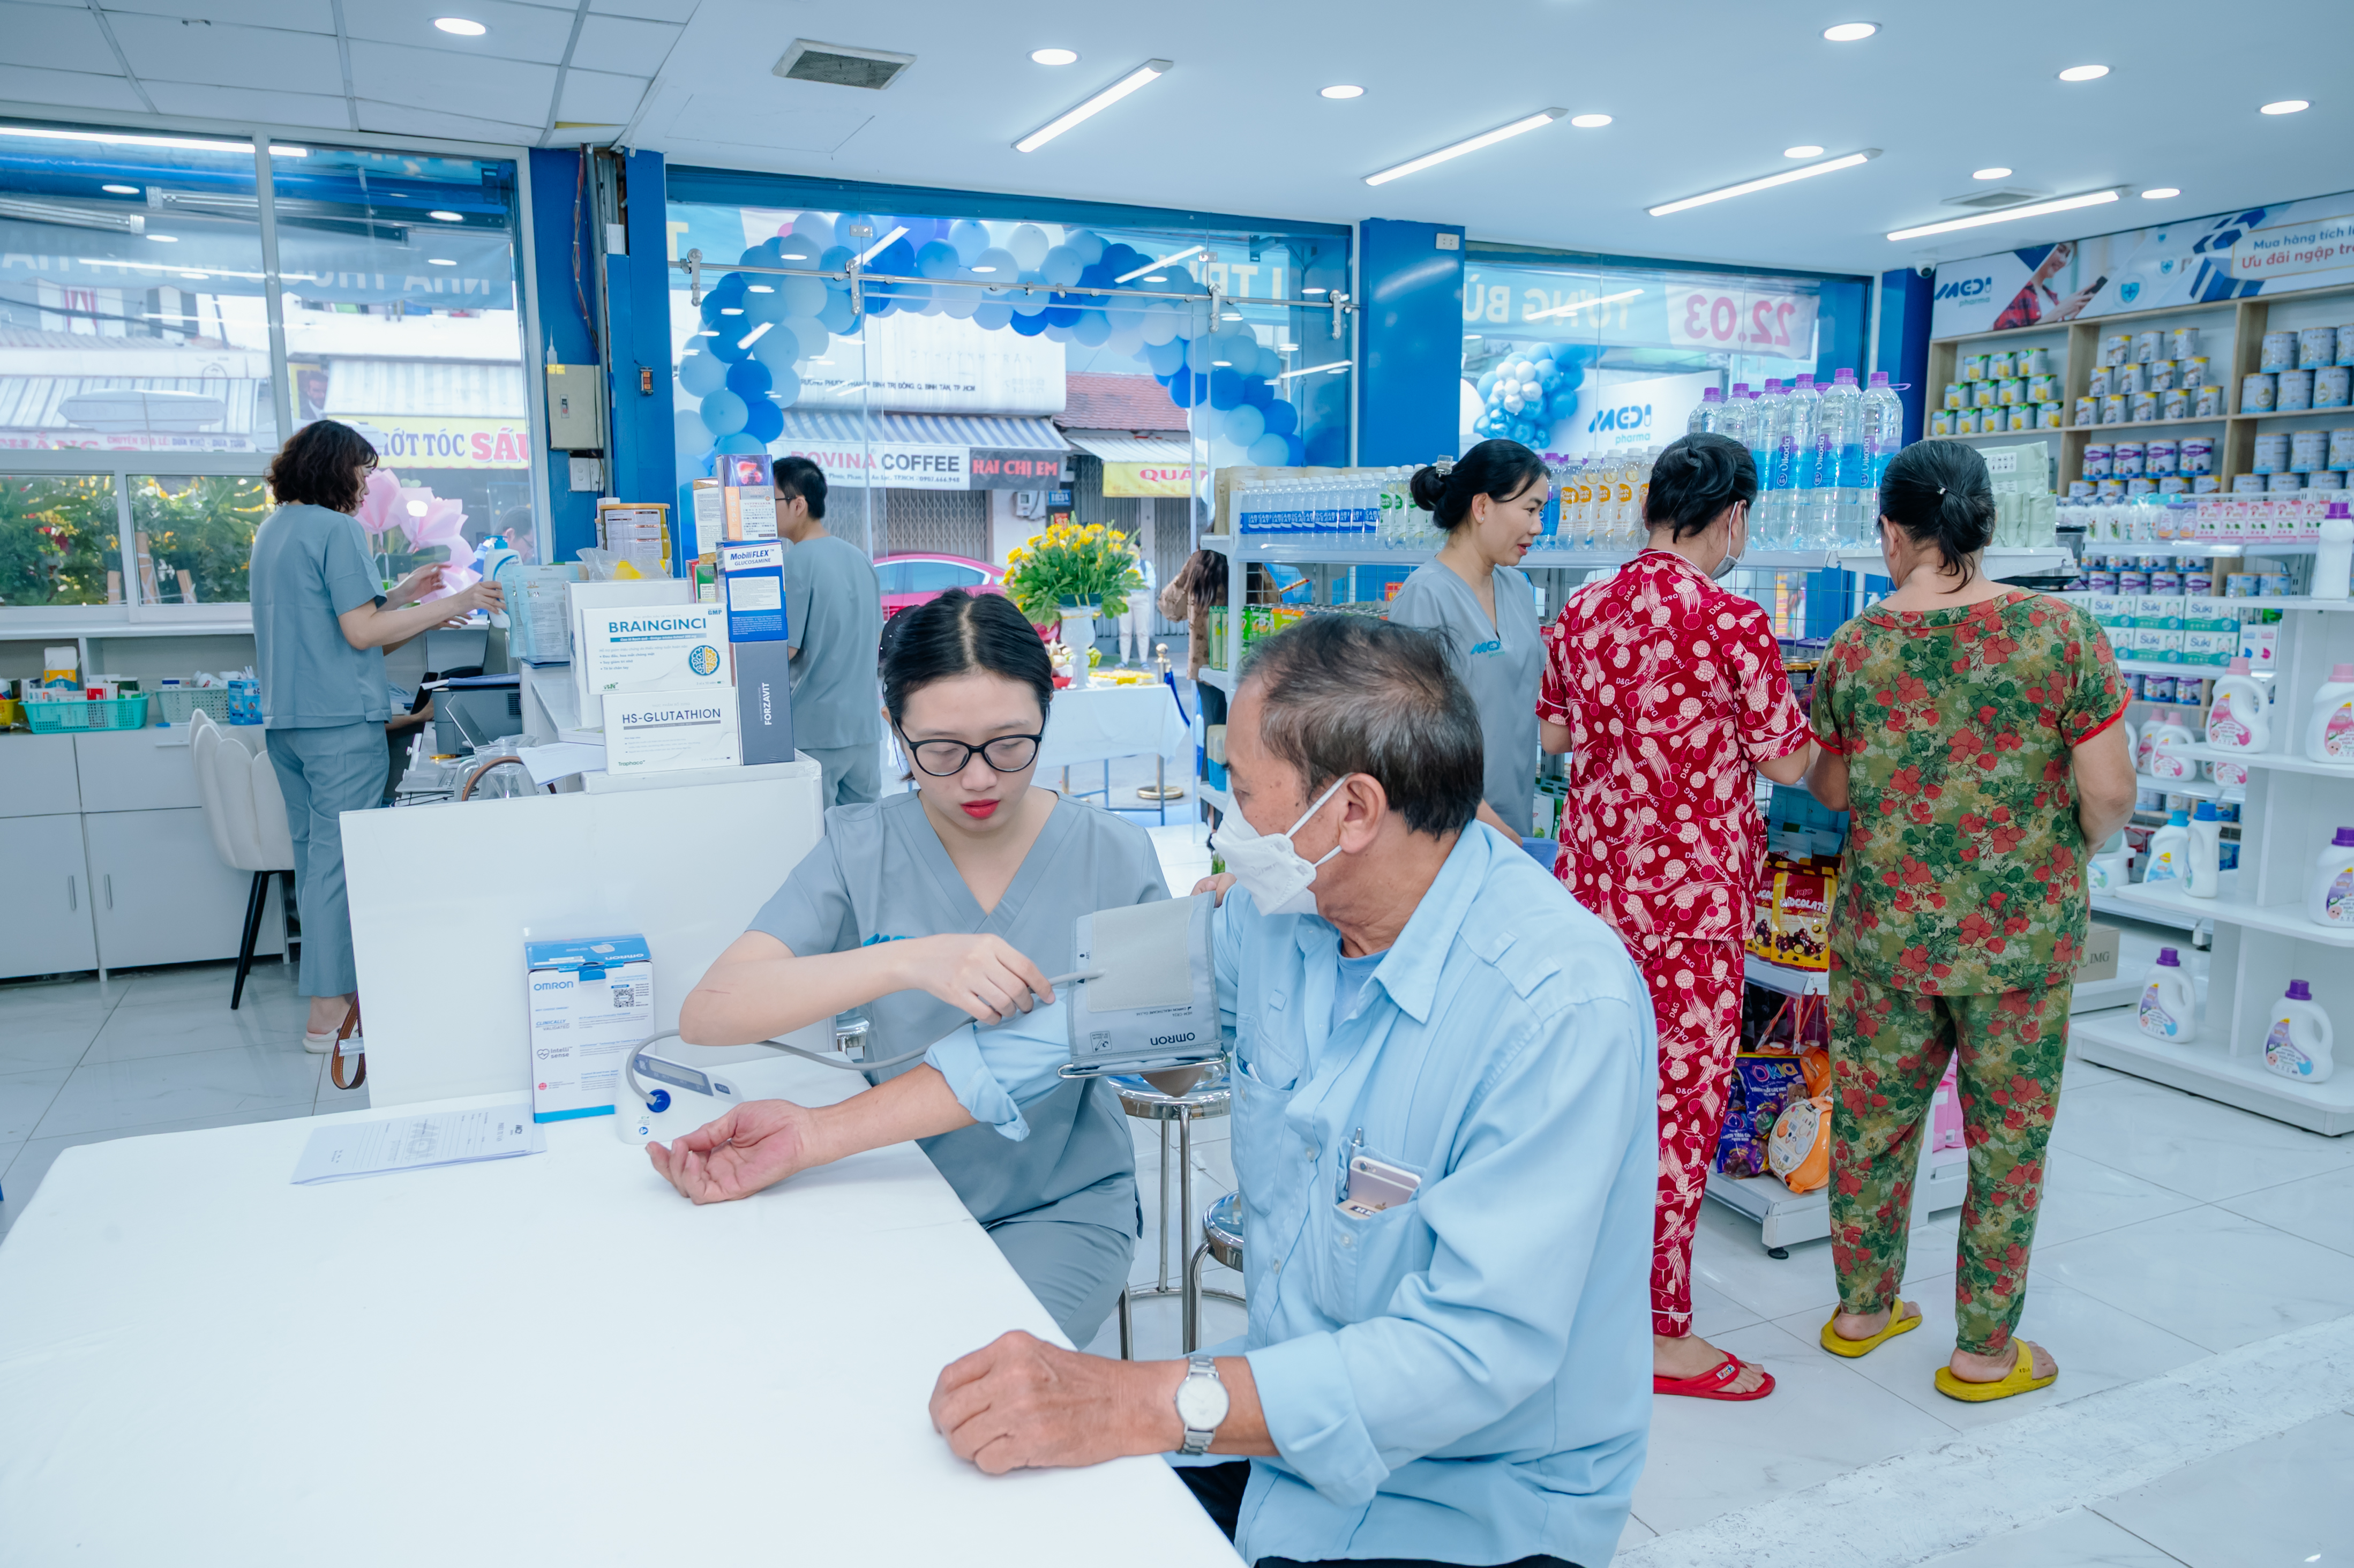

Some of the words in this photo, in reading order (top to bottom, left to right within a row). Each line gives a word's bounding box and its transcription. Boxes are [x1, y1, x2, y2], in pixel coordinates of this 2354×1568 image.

[2253, 239, 2280, 251] Mua
[1935, 276, 1992, 300] MEDI
[1588, 403, 1652, 434] MEDI
[423, 428, 466, 457] TÓC
[1615, 433, 1651, 446] pharma
[881, 454, 960, 472] COFFEE
[972, 460, 1000, 474] HAI
[1004, 460, 1032, 478] CHỊ
[1036, 461, 1058, 476] EM
[734, 558, 771, 566] GLUCOSAMINE
[1708, 600, 1726, 615] D&G
[609, 618, 707, 633] BRAINGINCI
[762, 682, 772, 725] FORZAVIT
[622, 708, 721, 724] HS-GLUTATHION
[1681, 762, 1692, 779] D&G
[1779, 896, 1829, 914] CHOCOLATE
[1681, 954, 1695, 968] D&G
[534, 981, 574, 991] OMRON
[1669, 1002, 1680, 1017] D&G
[1150, 1032, 1195, 1045] OMRON
